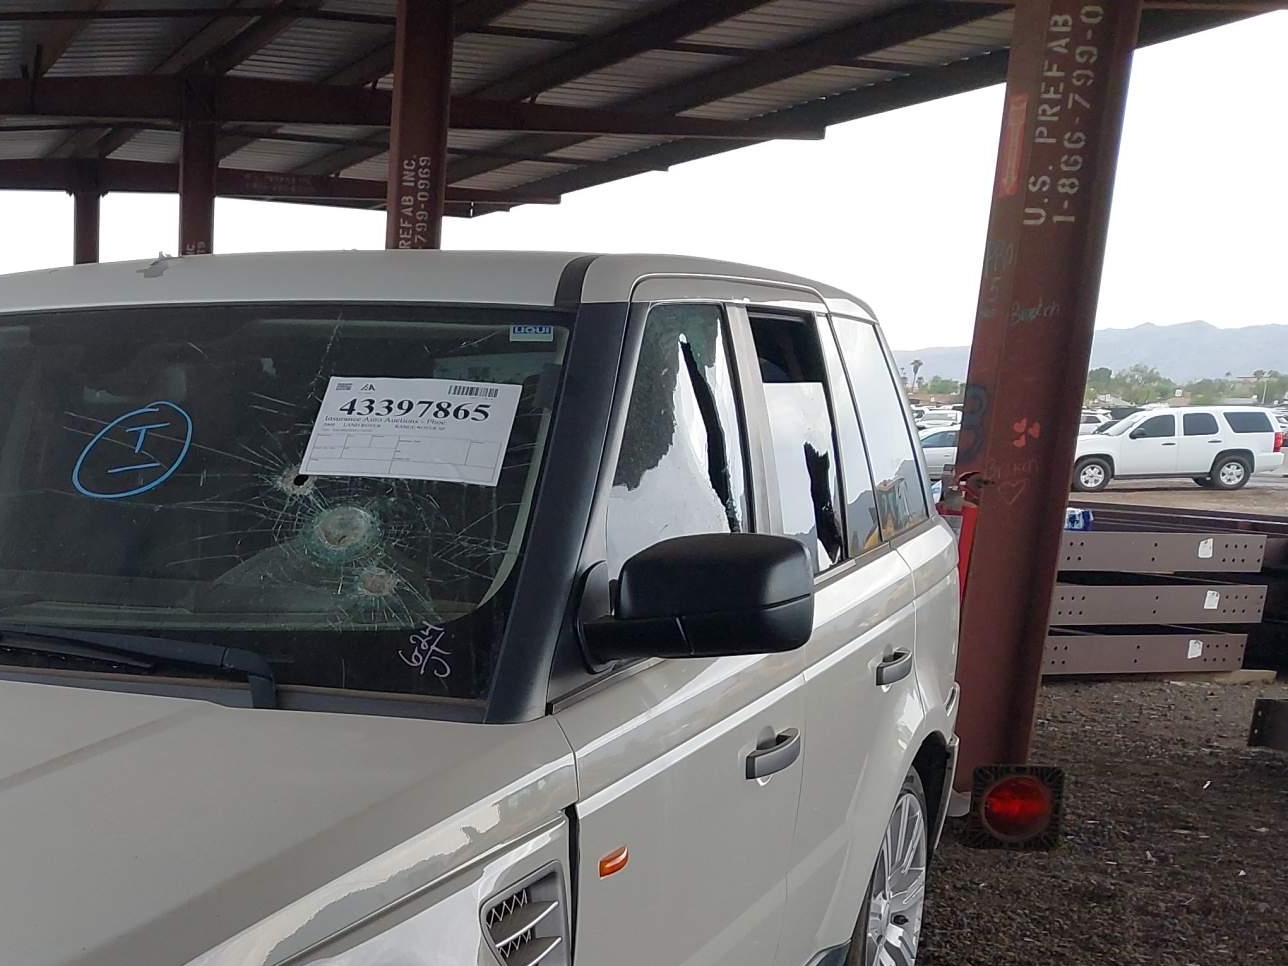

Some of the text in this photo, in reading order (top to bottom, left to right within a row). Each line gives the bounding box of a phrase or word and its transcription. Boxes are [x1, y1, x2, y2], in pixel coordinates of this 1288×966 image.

[1023, 13, 1072, 226] U.S. PREFAB
[339, 398, 492, 422] 43397865
